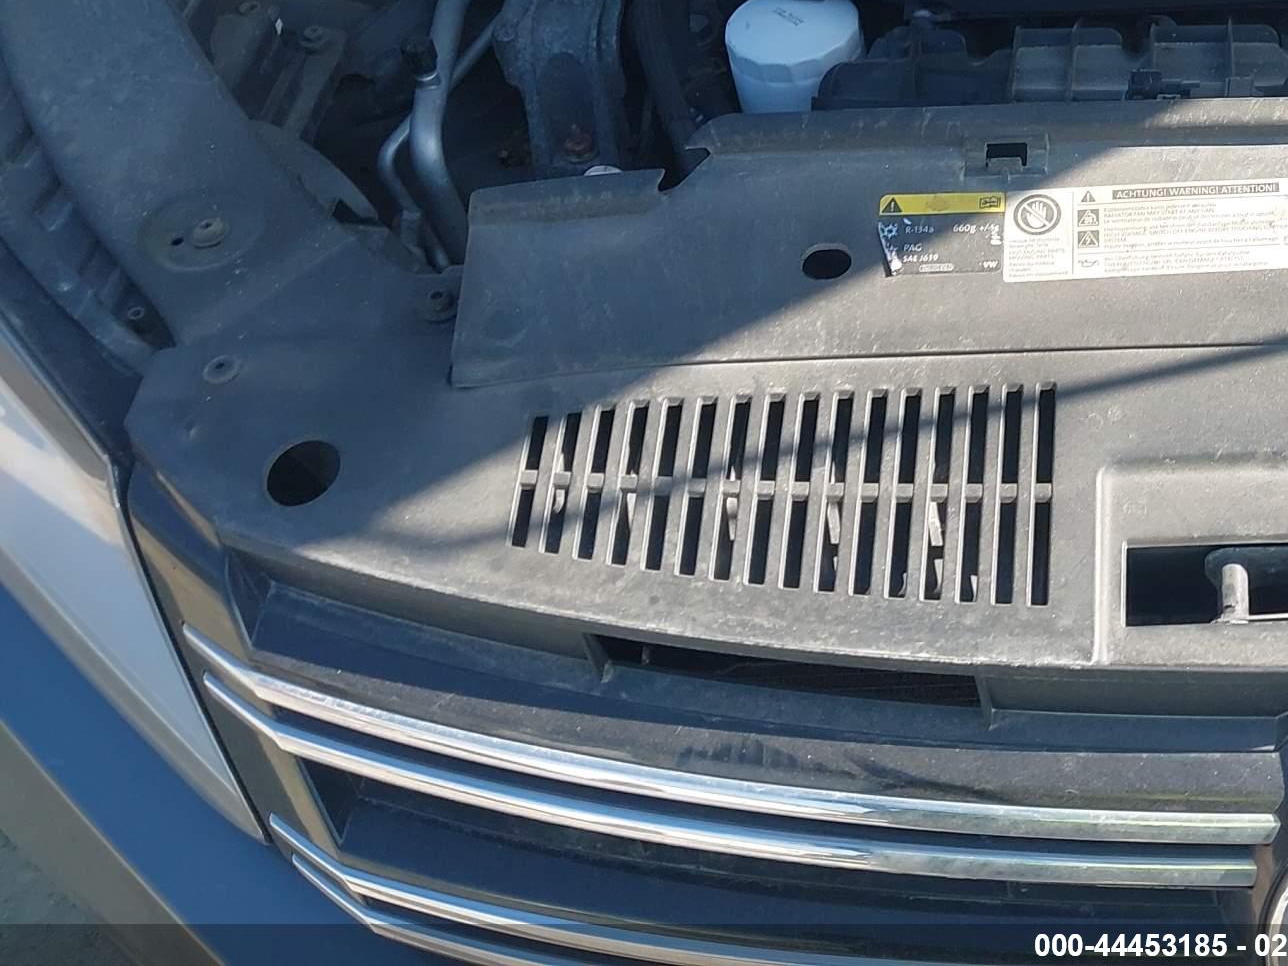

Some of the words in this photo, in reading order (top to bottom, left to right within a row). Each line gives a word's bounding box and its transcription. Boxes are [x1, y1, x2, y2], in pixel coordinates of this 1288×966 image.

[1116, 189, 1168, 199] ACHTUNG!
[1170, 186, 1219, 196] WARNING!
[1221, 184, 1276, 194] ATTENTION!
[952, 223, 977, 234] 660g
[903, 243, 922, 252] PAG
